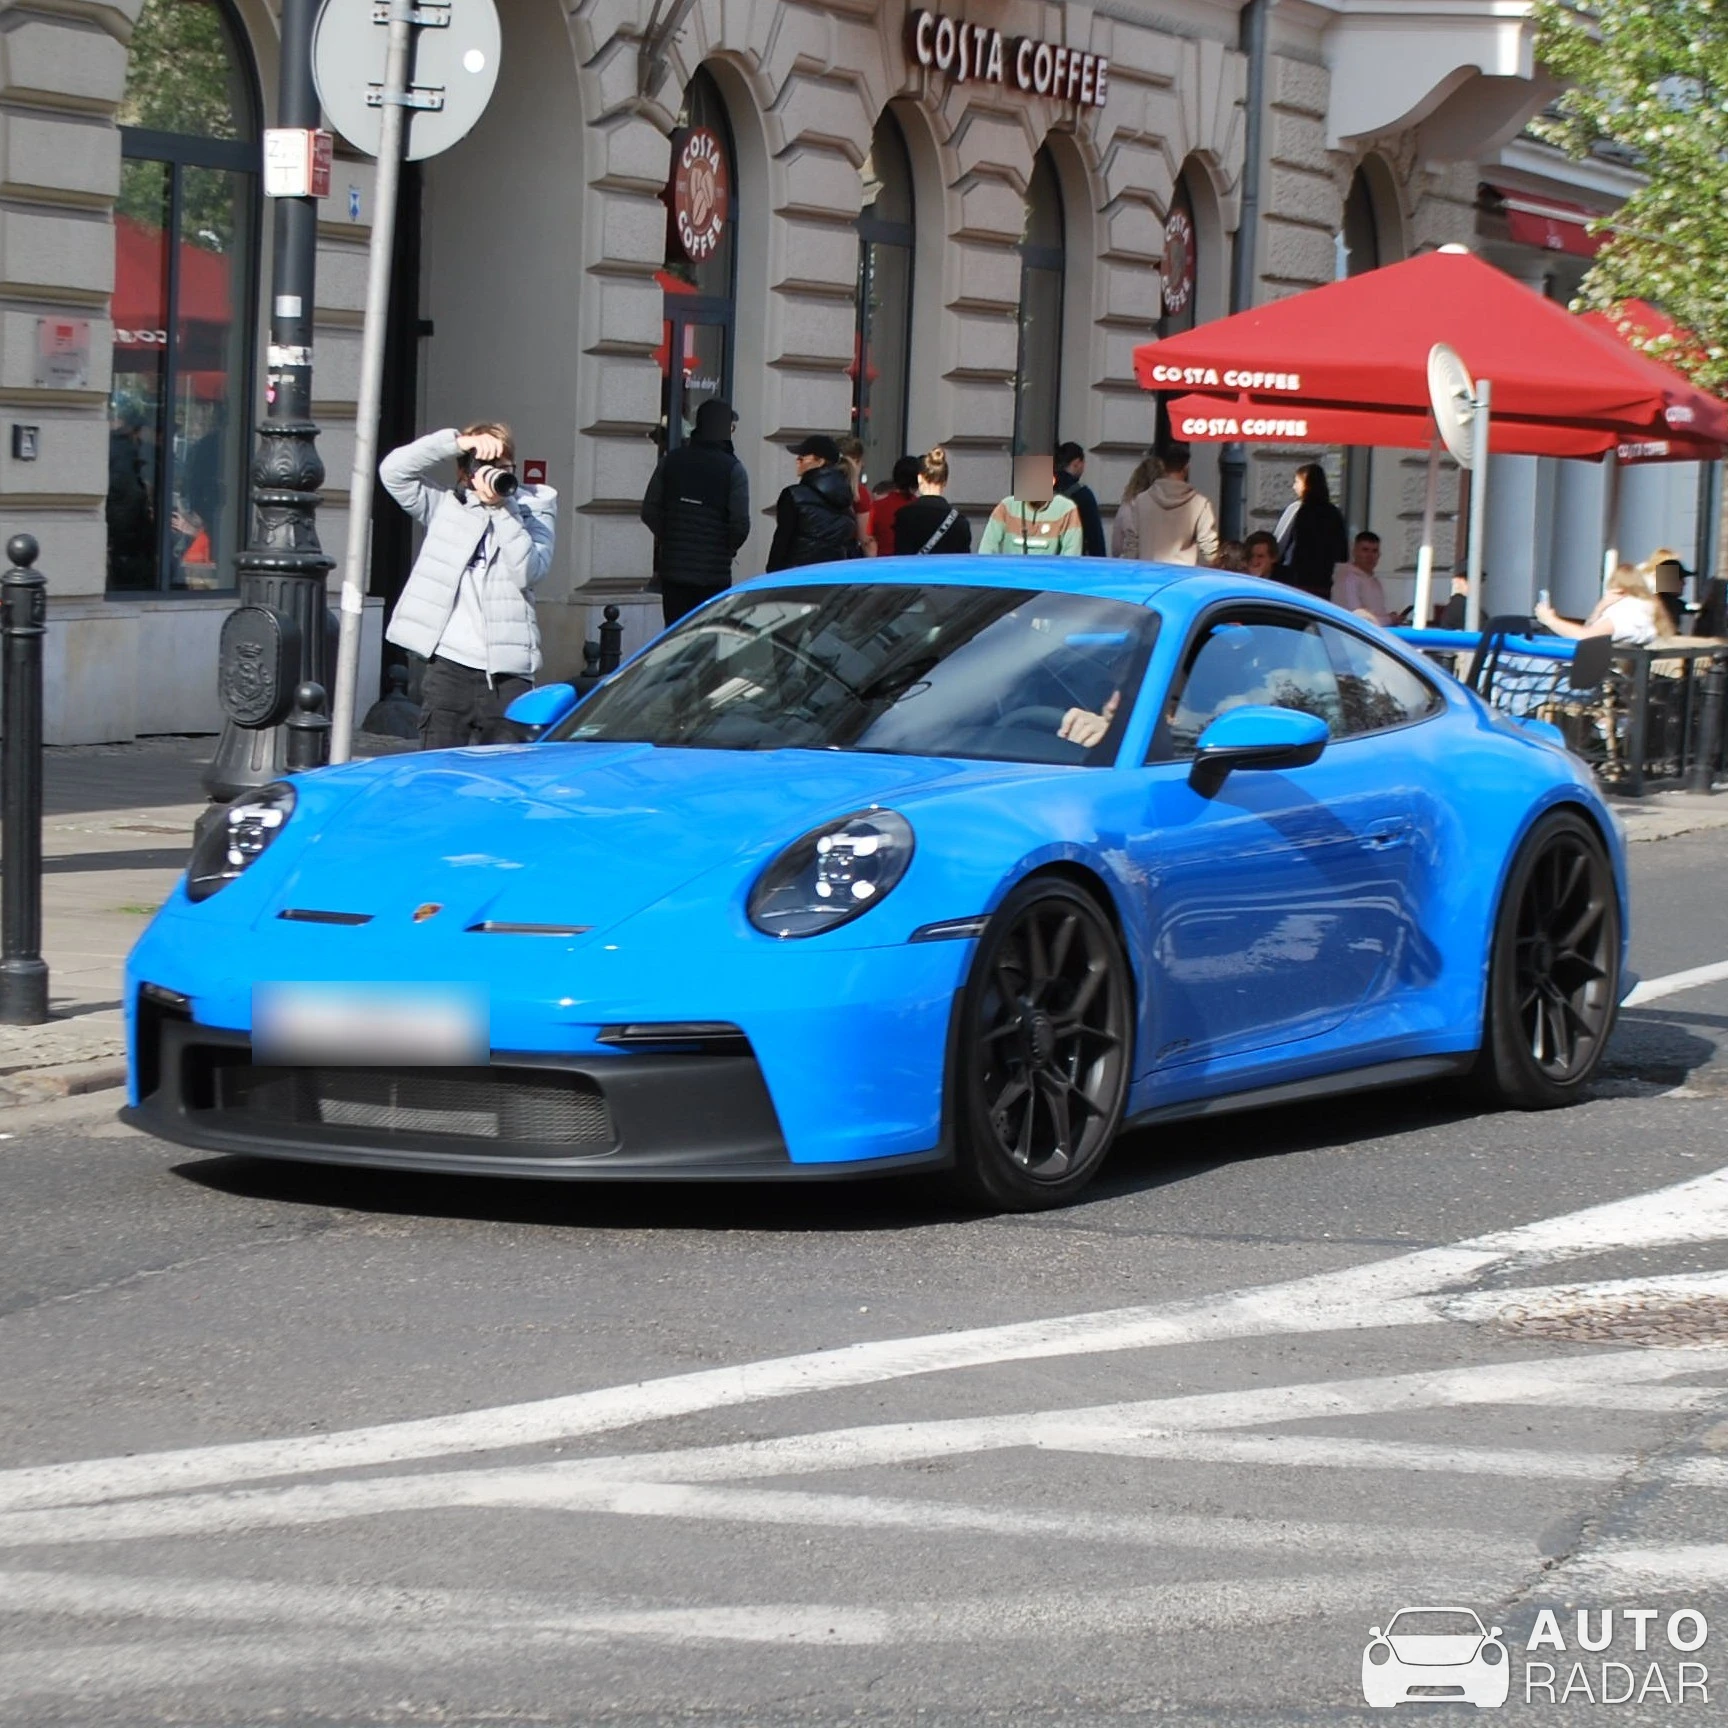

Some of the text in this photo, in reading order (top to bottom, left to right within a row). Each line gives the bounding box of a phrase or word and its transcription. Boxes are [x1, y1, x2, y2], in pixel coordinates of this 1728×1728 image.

[917, 11, 1108, 106] COSTA COFFEE
[683, 134, 720, 175] COSTA
[678, 211, 722, 257] COFFEE
[1152, 365, 1300, 391] COSTA COFFEE
[1182, 418, 1307, 437] COSTA COFFEE
